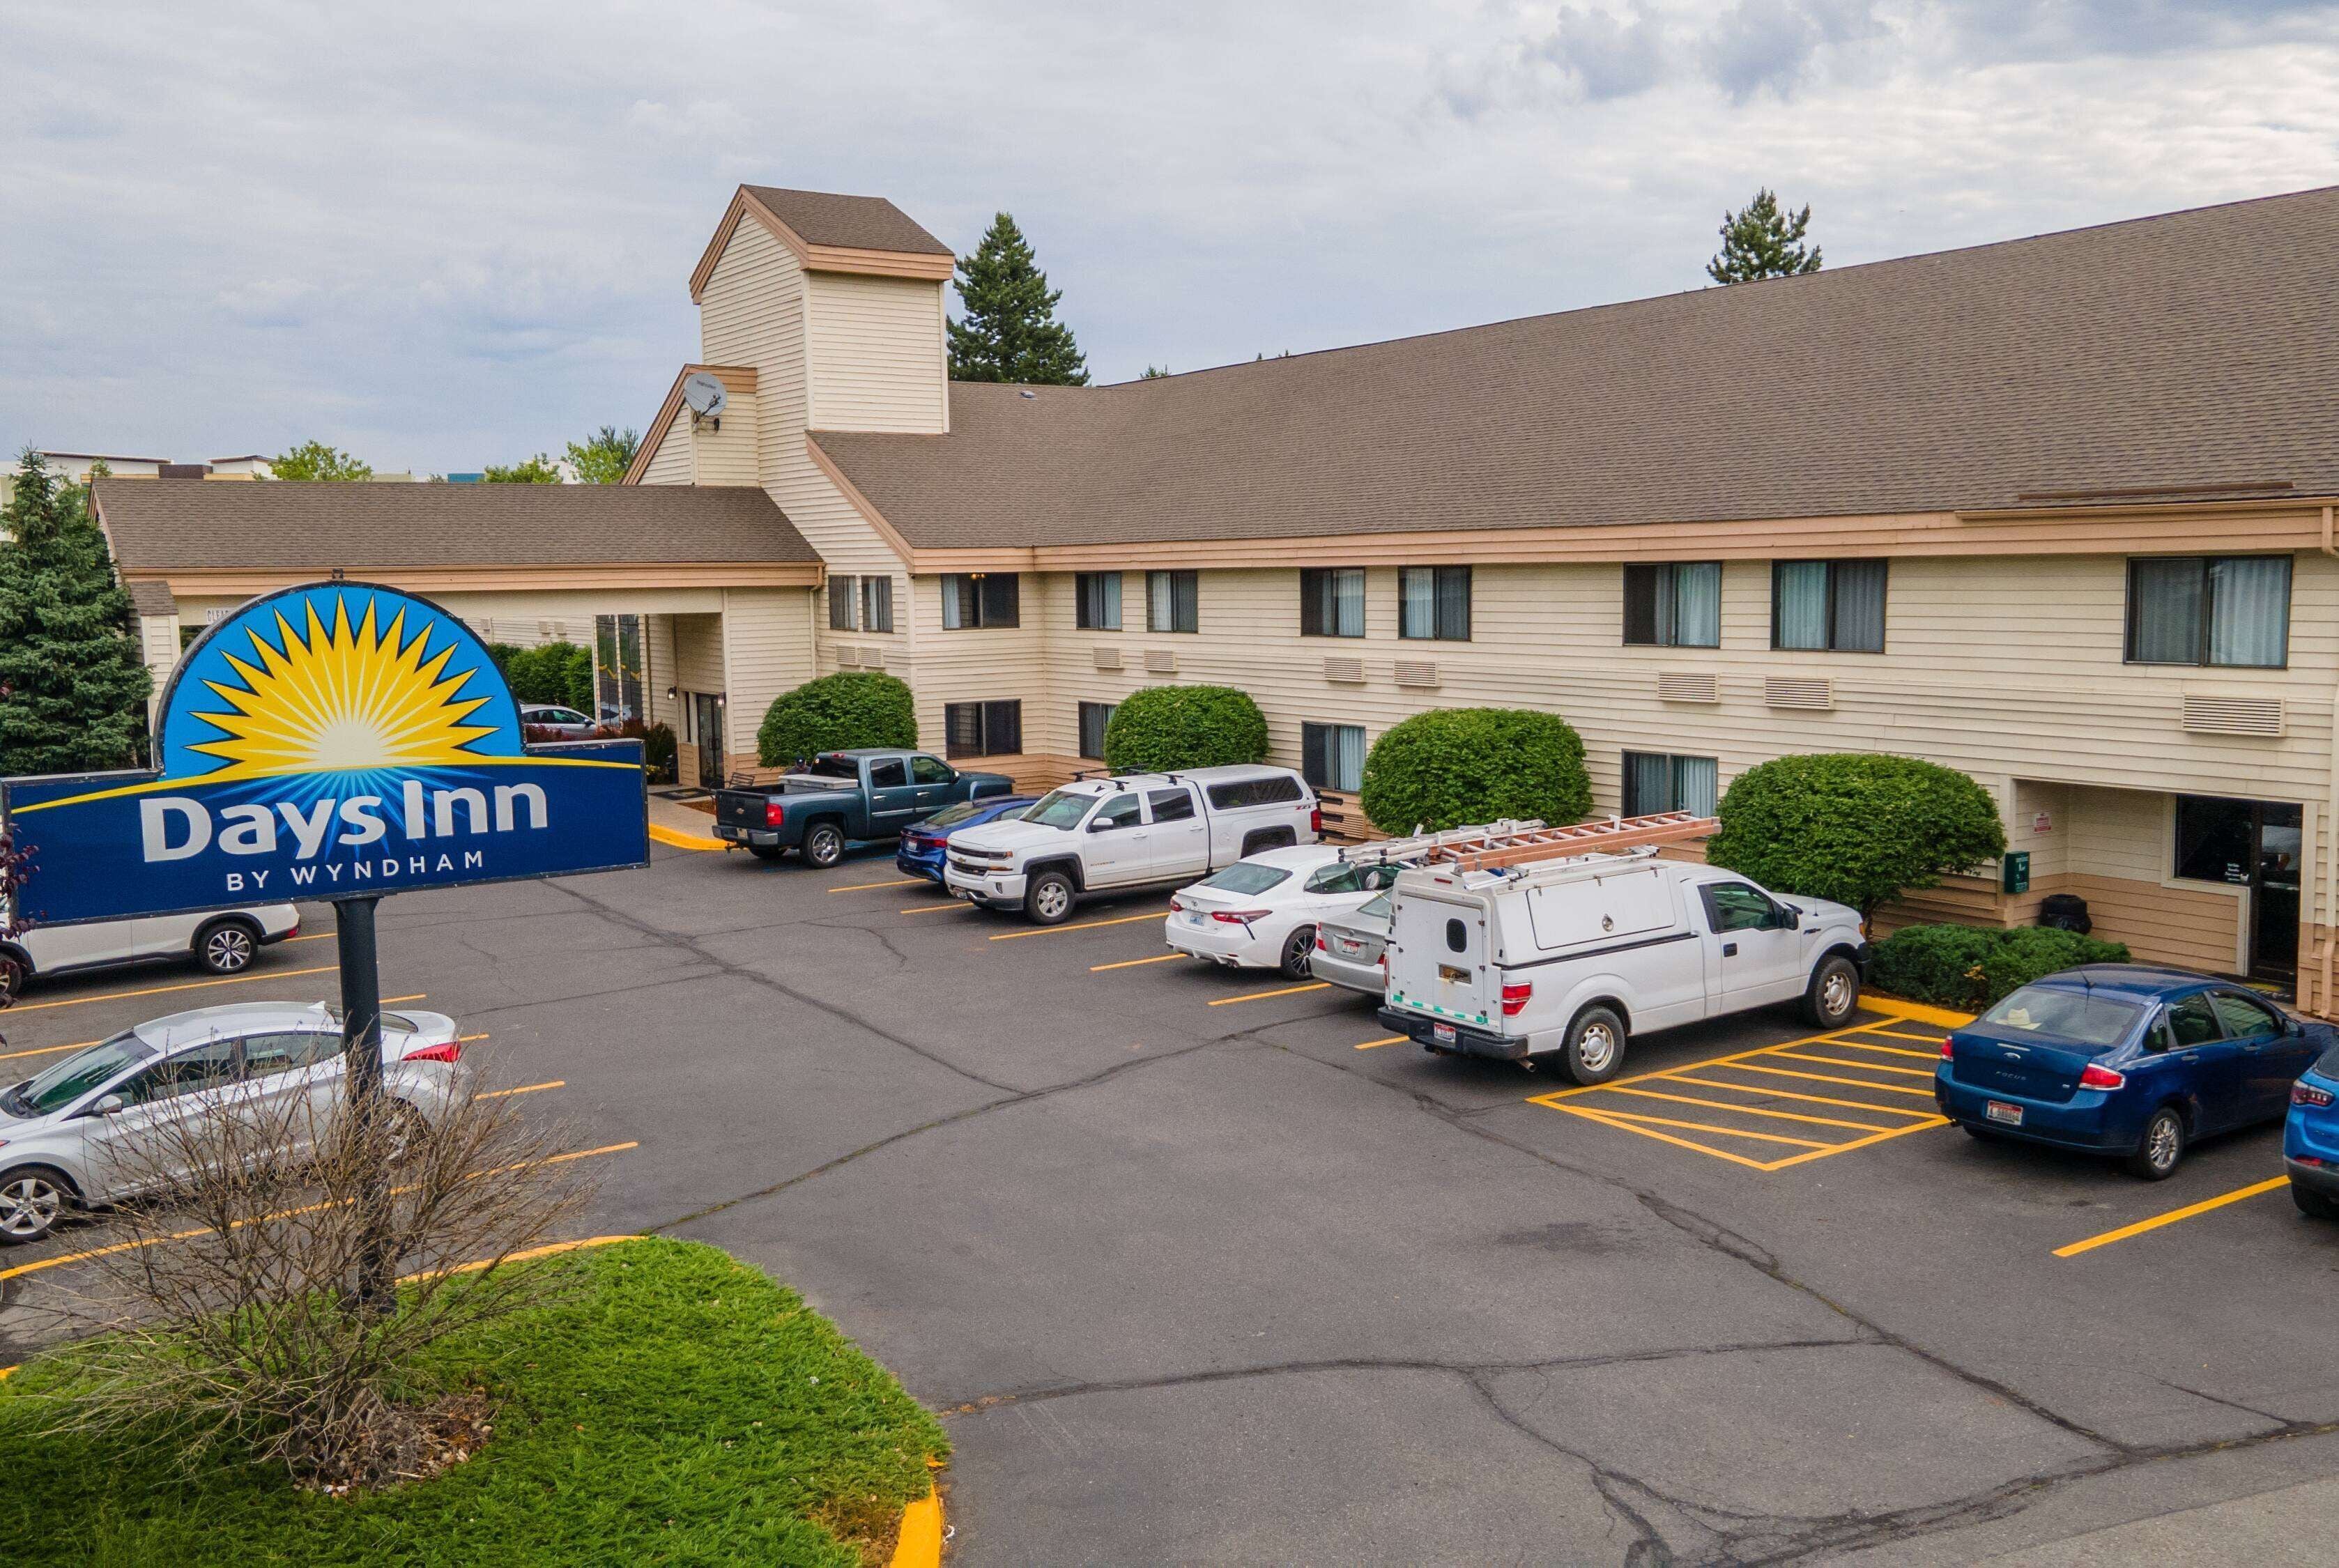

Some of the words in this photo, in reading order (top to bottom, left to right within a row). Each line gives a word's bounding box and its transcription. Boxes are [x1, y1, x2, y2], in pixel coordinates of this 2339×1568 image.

[139, 796, 386, 863] Days
[403, 780, 548, 840] Inn
[227, 870, 269, 891] BY
[290, 850, 483, 885] WYNDHAM
